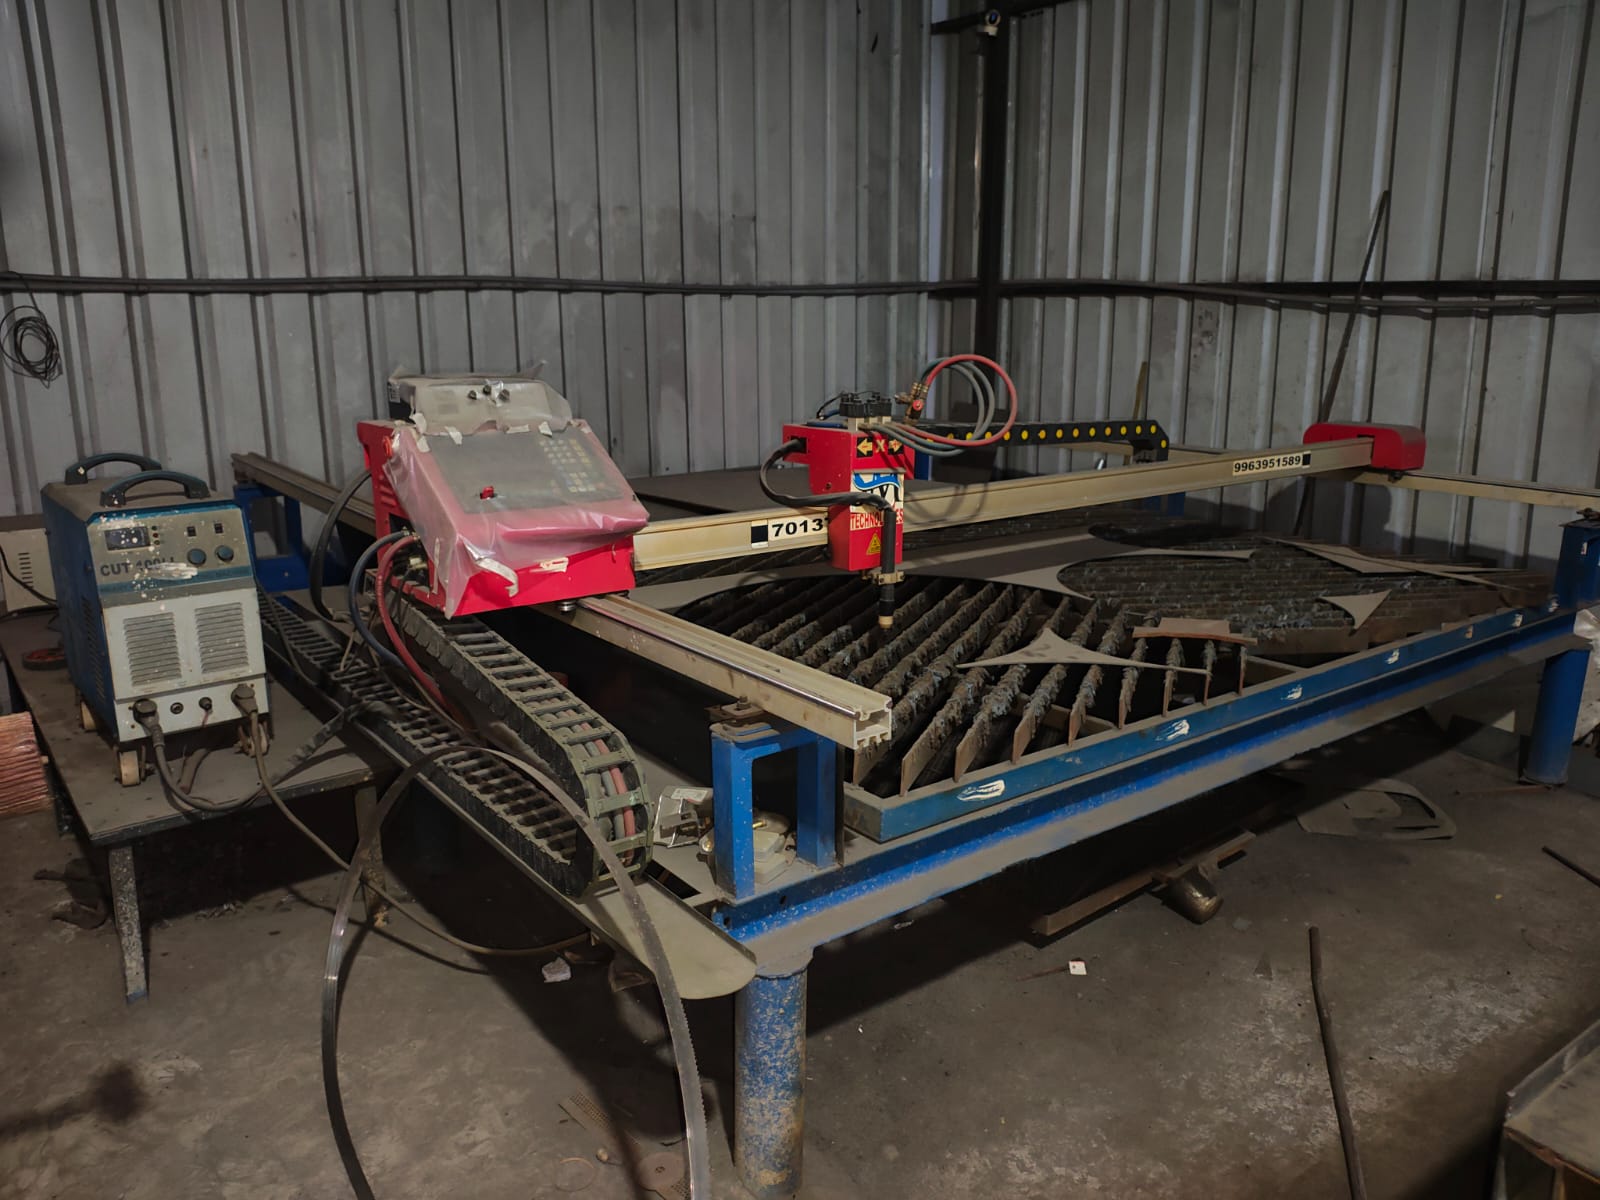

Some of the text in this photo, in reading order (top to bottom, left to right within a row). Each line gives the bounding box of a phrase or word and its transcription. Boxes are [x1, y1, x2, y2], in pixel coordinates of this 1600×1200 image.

[875, 438, 886, 453] X
[1234, 455, 1301, 472] 9963951589
[771, 517, 828, 537] 7013
[850, 509, 903, 528] TECHNOLES
[101, 562, 131, 576] CUT
